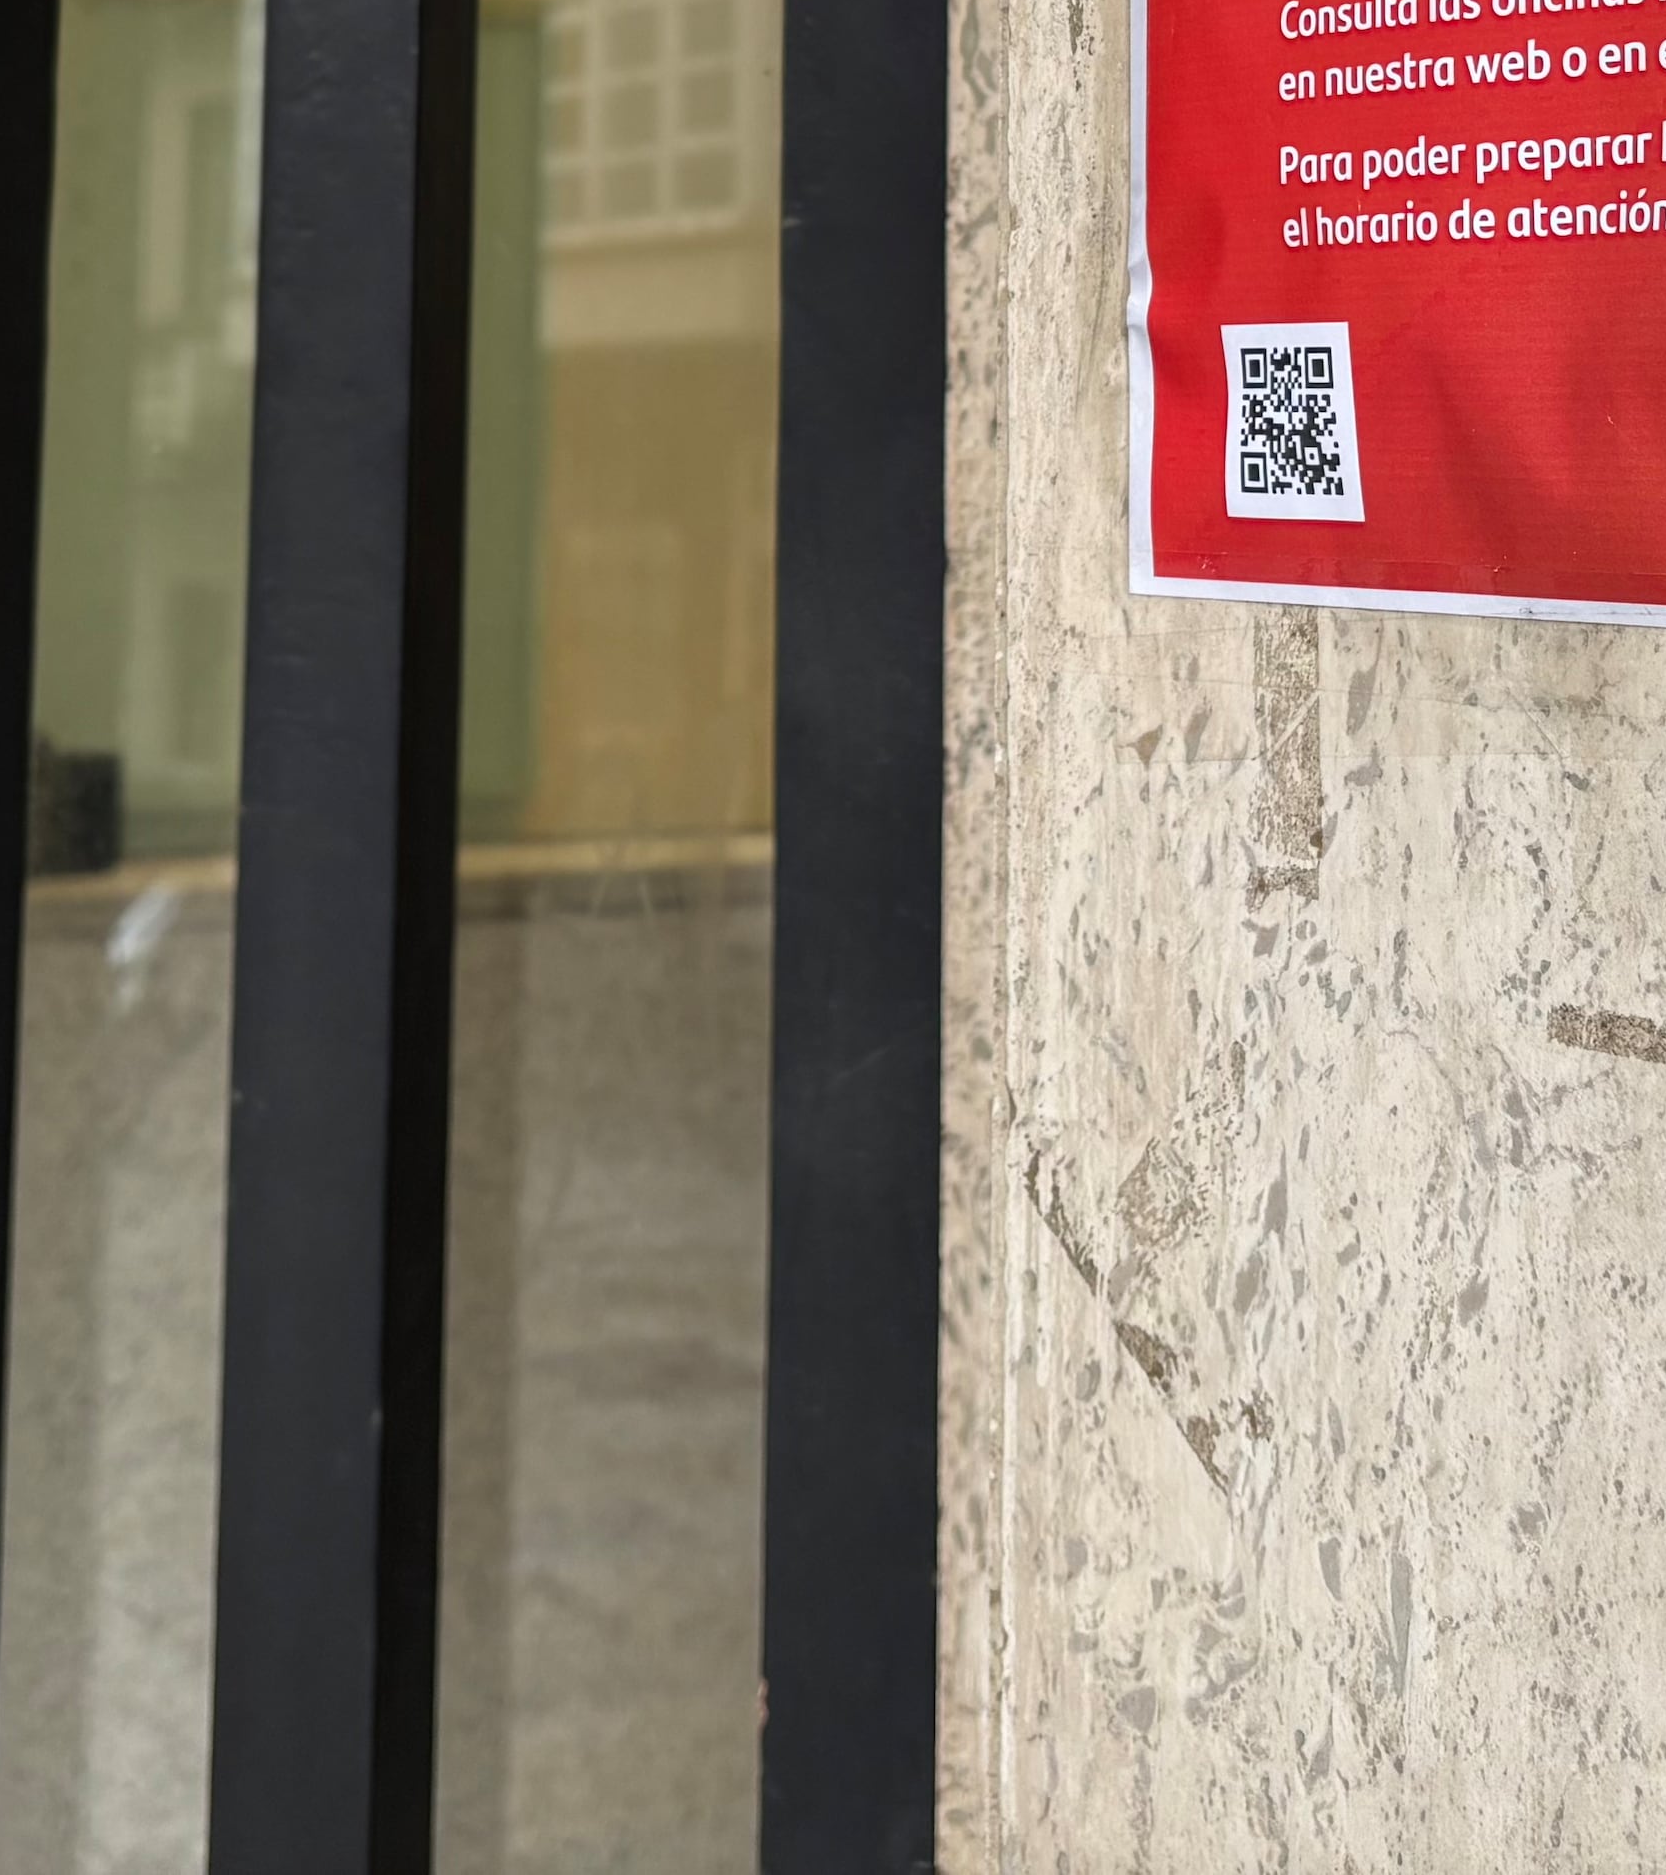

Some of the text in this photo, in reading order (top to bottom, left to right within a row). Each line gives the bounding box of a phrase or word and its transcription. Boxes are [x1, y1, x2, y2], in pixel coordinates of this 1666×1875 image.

[1278, 70, 1316, 101] en
[1325, 52, 1455, 97] nuestra
[1465, 38, 1551, 84] web
[1562, 46, 1587, 78] o
[1598, 41, 1647, 75] en
[1280, 145, 1353, 185] Para
[1363, 135, 1467, 191] poder
[1476, 132, 1653, 184] preparar
[1283, 207, 1309, 248] el
[1315, 206, 1438, 246] horario
[1448, 197, 1496, 240] de
